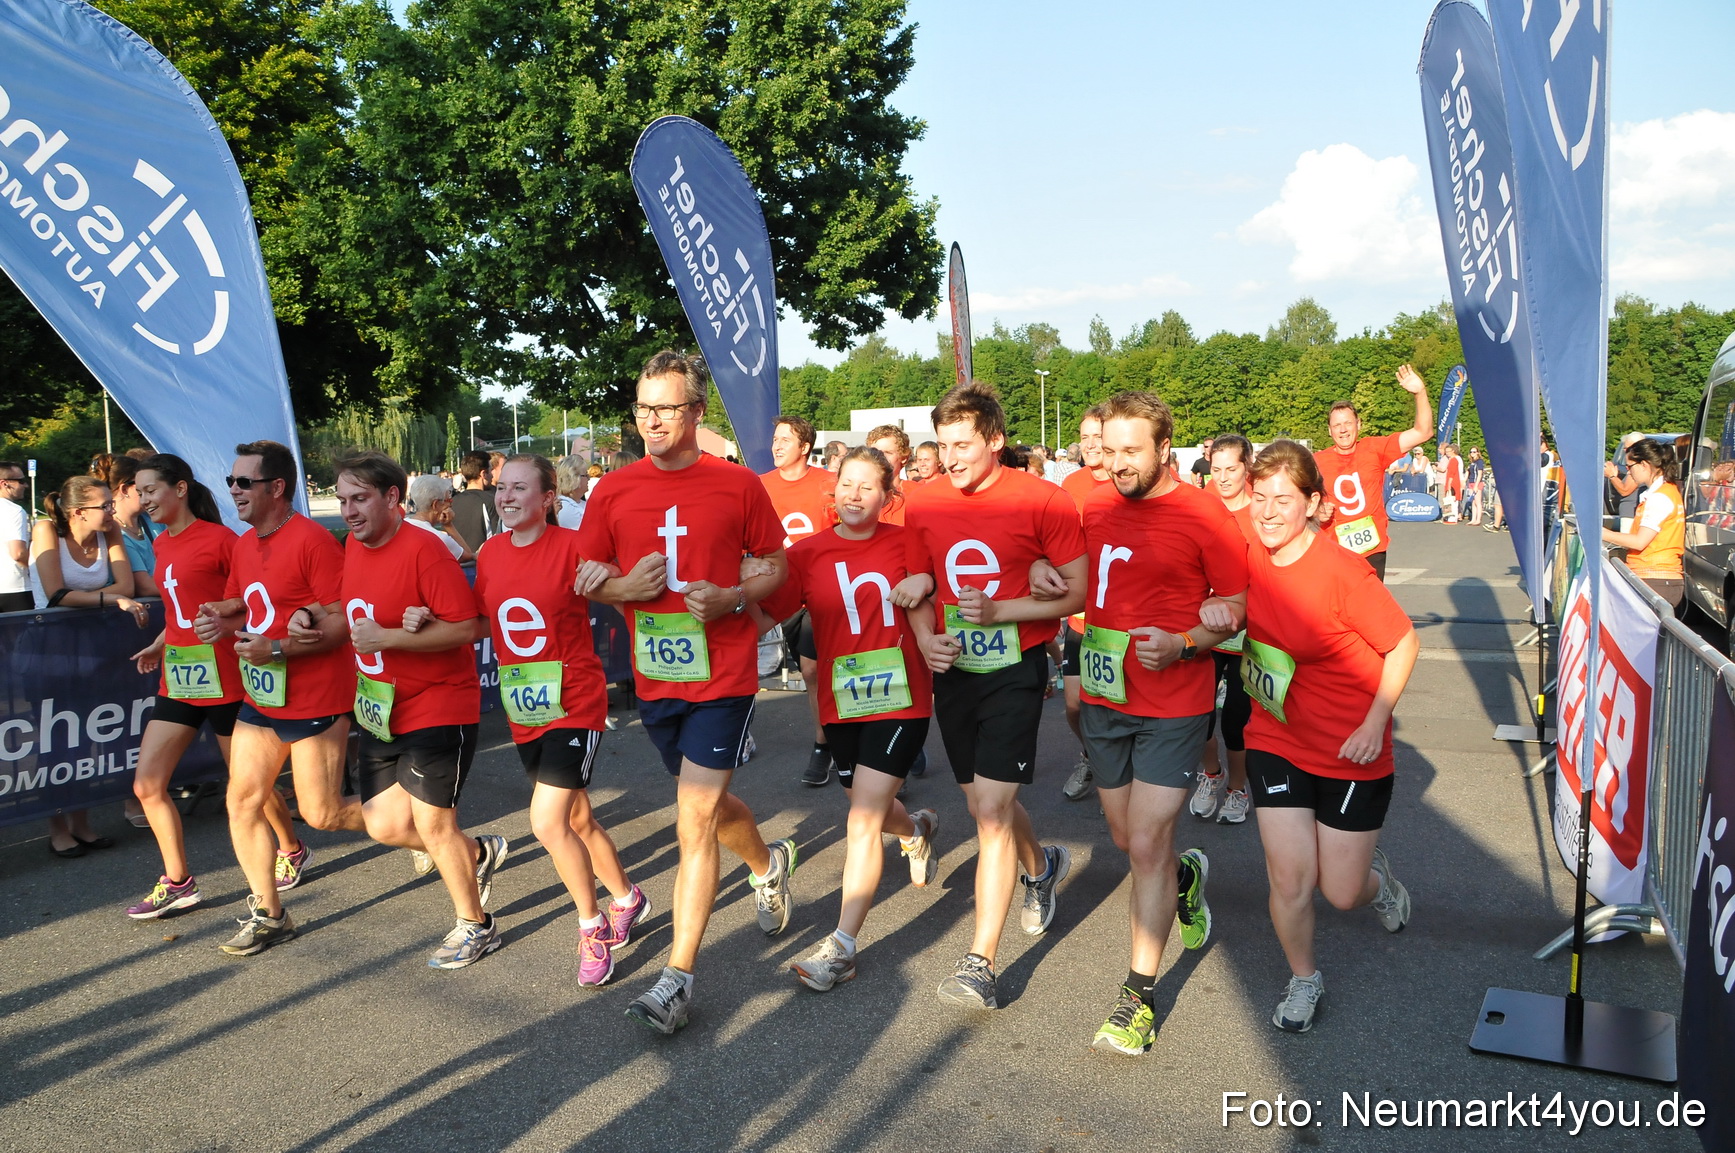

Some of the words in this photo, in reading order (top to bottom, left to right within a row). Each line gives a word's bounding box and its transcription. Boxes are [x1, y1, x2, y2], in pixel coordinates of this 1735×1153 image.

[1334, 471, 1366, 516] g
[781, 512, 814, 548] e
[1345, 529, 1373, 547] 188
[657, 505, 688, 593] t
[945, 539, 1001, 600] e
[1096, 543, 1134, 609] r
[163, 563, 193, 629] t
[834, 561, 895, 635] h
[497, 597, 548, 657] e
[955, 629, 1008, 657] 184
[644, 637, 695, 665] 163
[1084, 650, 1115, 684] 185
[171, 664, 211, 686] 172
[243, 663, 275, 694] 160
[844, 672, 893, 701] 177
[358, 696, 383, 727] 186
[510, 685, 551, 712] 164
